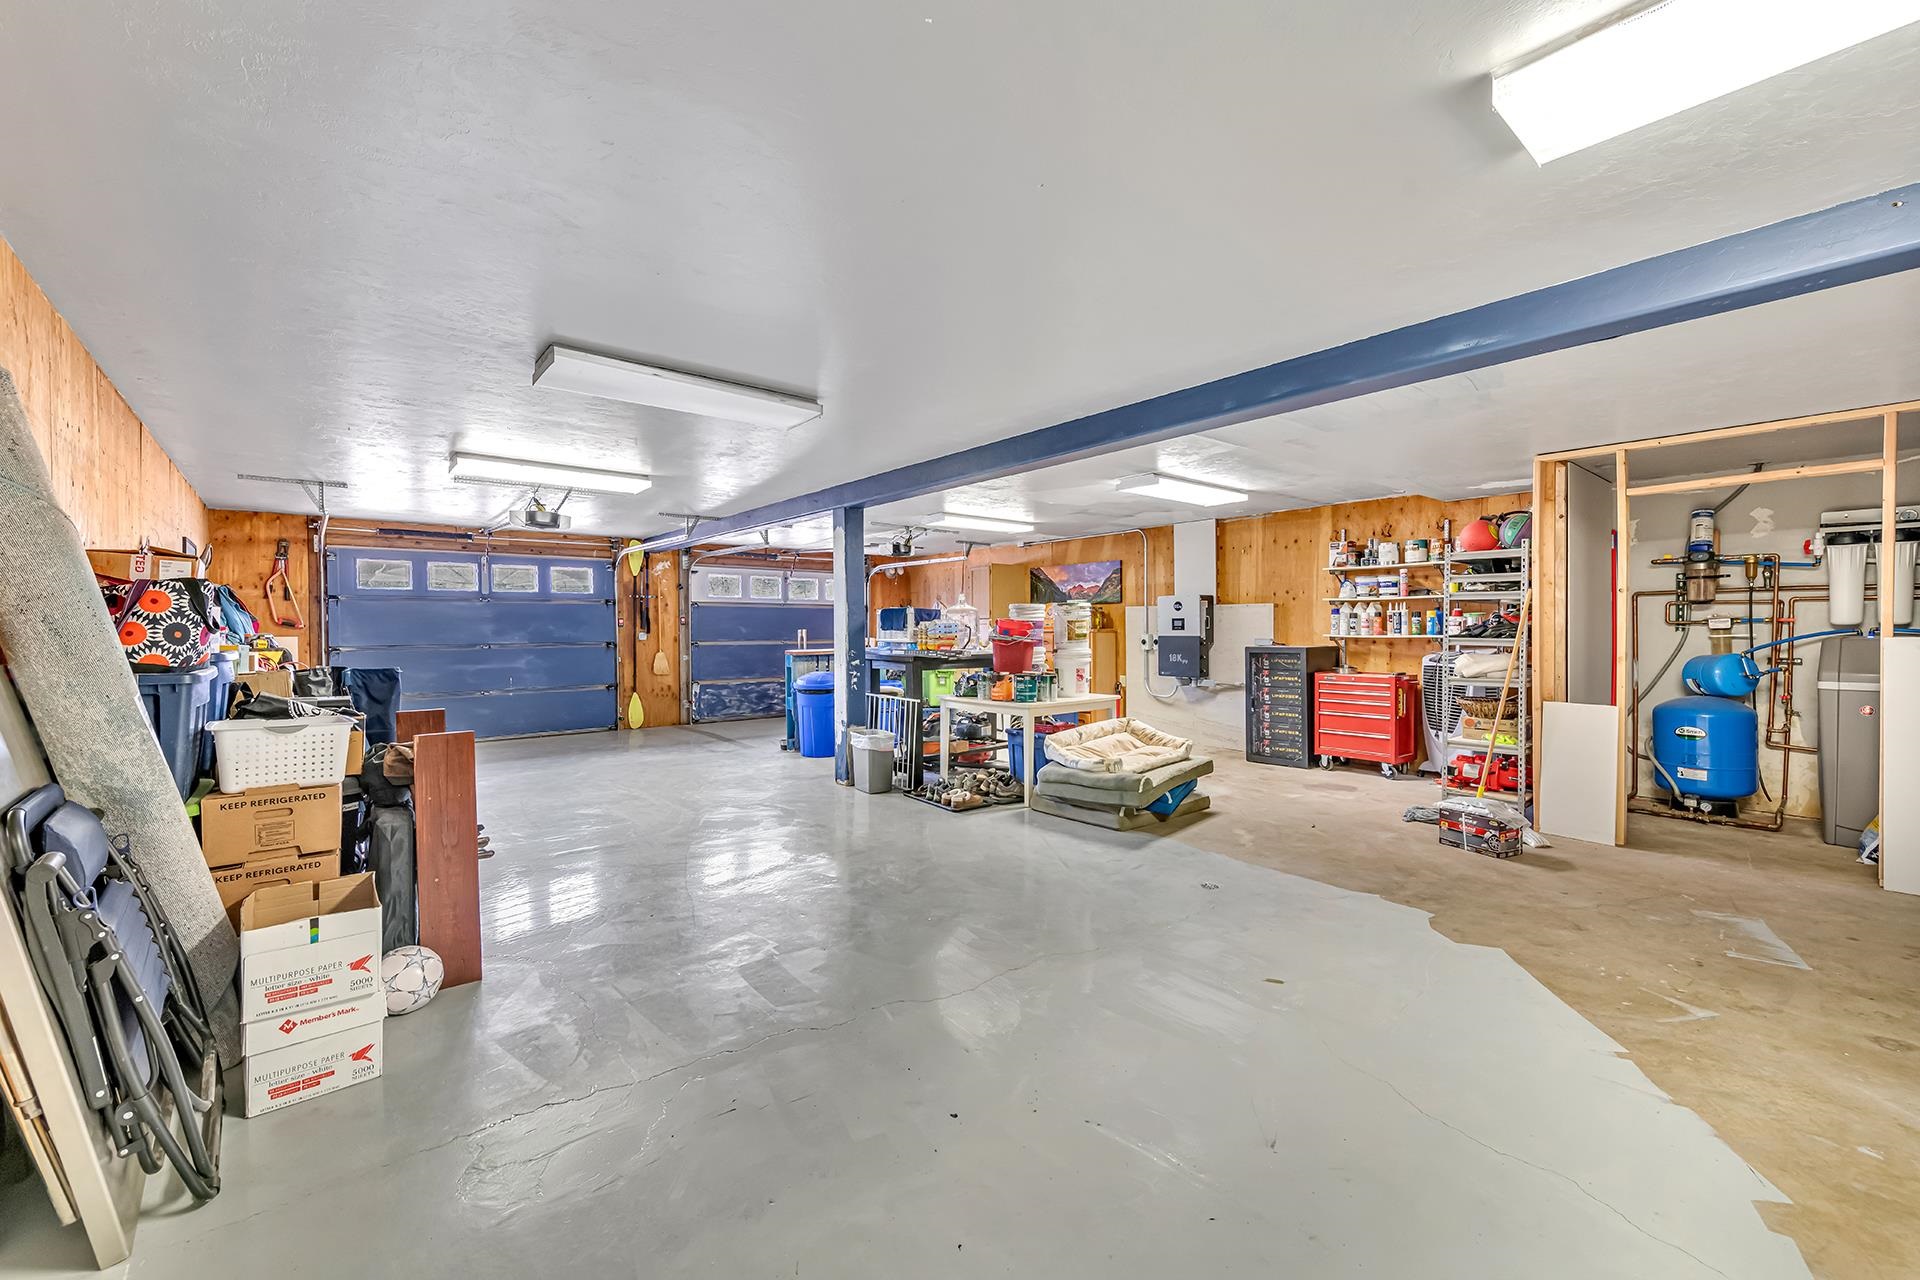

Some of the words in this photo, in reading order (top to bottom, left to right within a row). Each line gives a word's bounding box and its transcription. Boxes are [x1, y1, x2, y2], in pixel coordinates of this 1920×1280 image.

[220, 801, 247, 811] KEEP
[250, 792, 326, 808] REFRIGERATED
[215, 873, 242, 884] KEEP
[245, 861, 322, 879] REFRIGERATED
[250, 967, 315, 987] MULTIPURPOSE
[317, 960, 343, 973] PAPER
[264, 982, 286, 992] letter
[287, 979, 302, 987] size
[309, 974, 330, 983] white
[350, 976, 373, 987] 5000
[299, 1012, 336, 1026] Member's
[254, 1060, 318, 1084] MULTIPURPOSE
[320, 1051, 345, 1065] PAPER
[268, 1077, 289, 1088] letter
[290, 1072, 306, 1081] size
[312, 1065, 333, 1076] white
[352, 1064, 375, 1077] 5000
